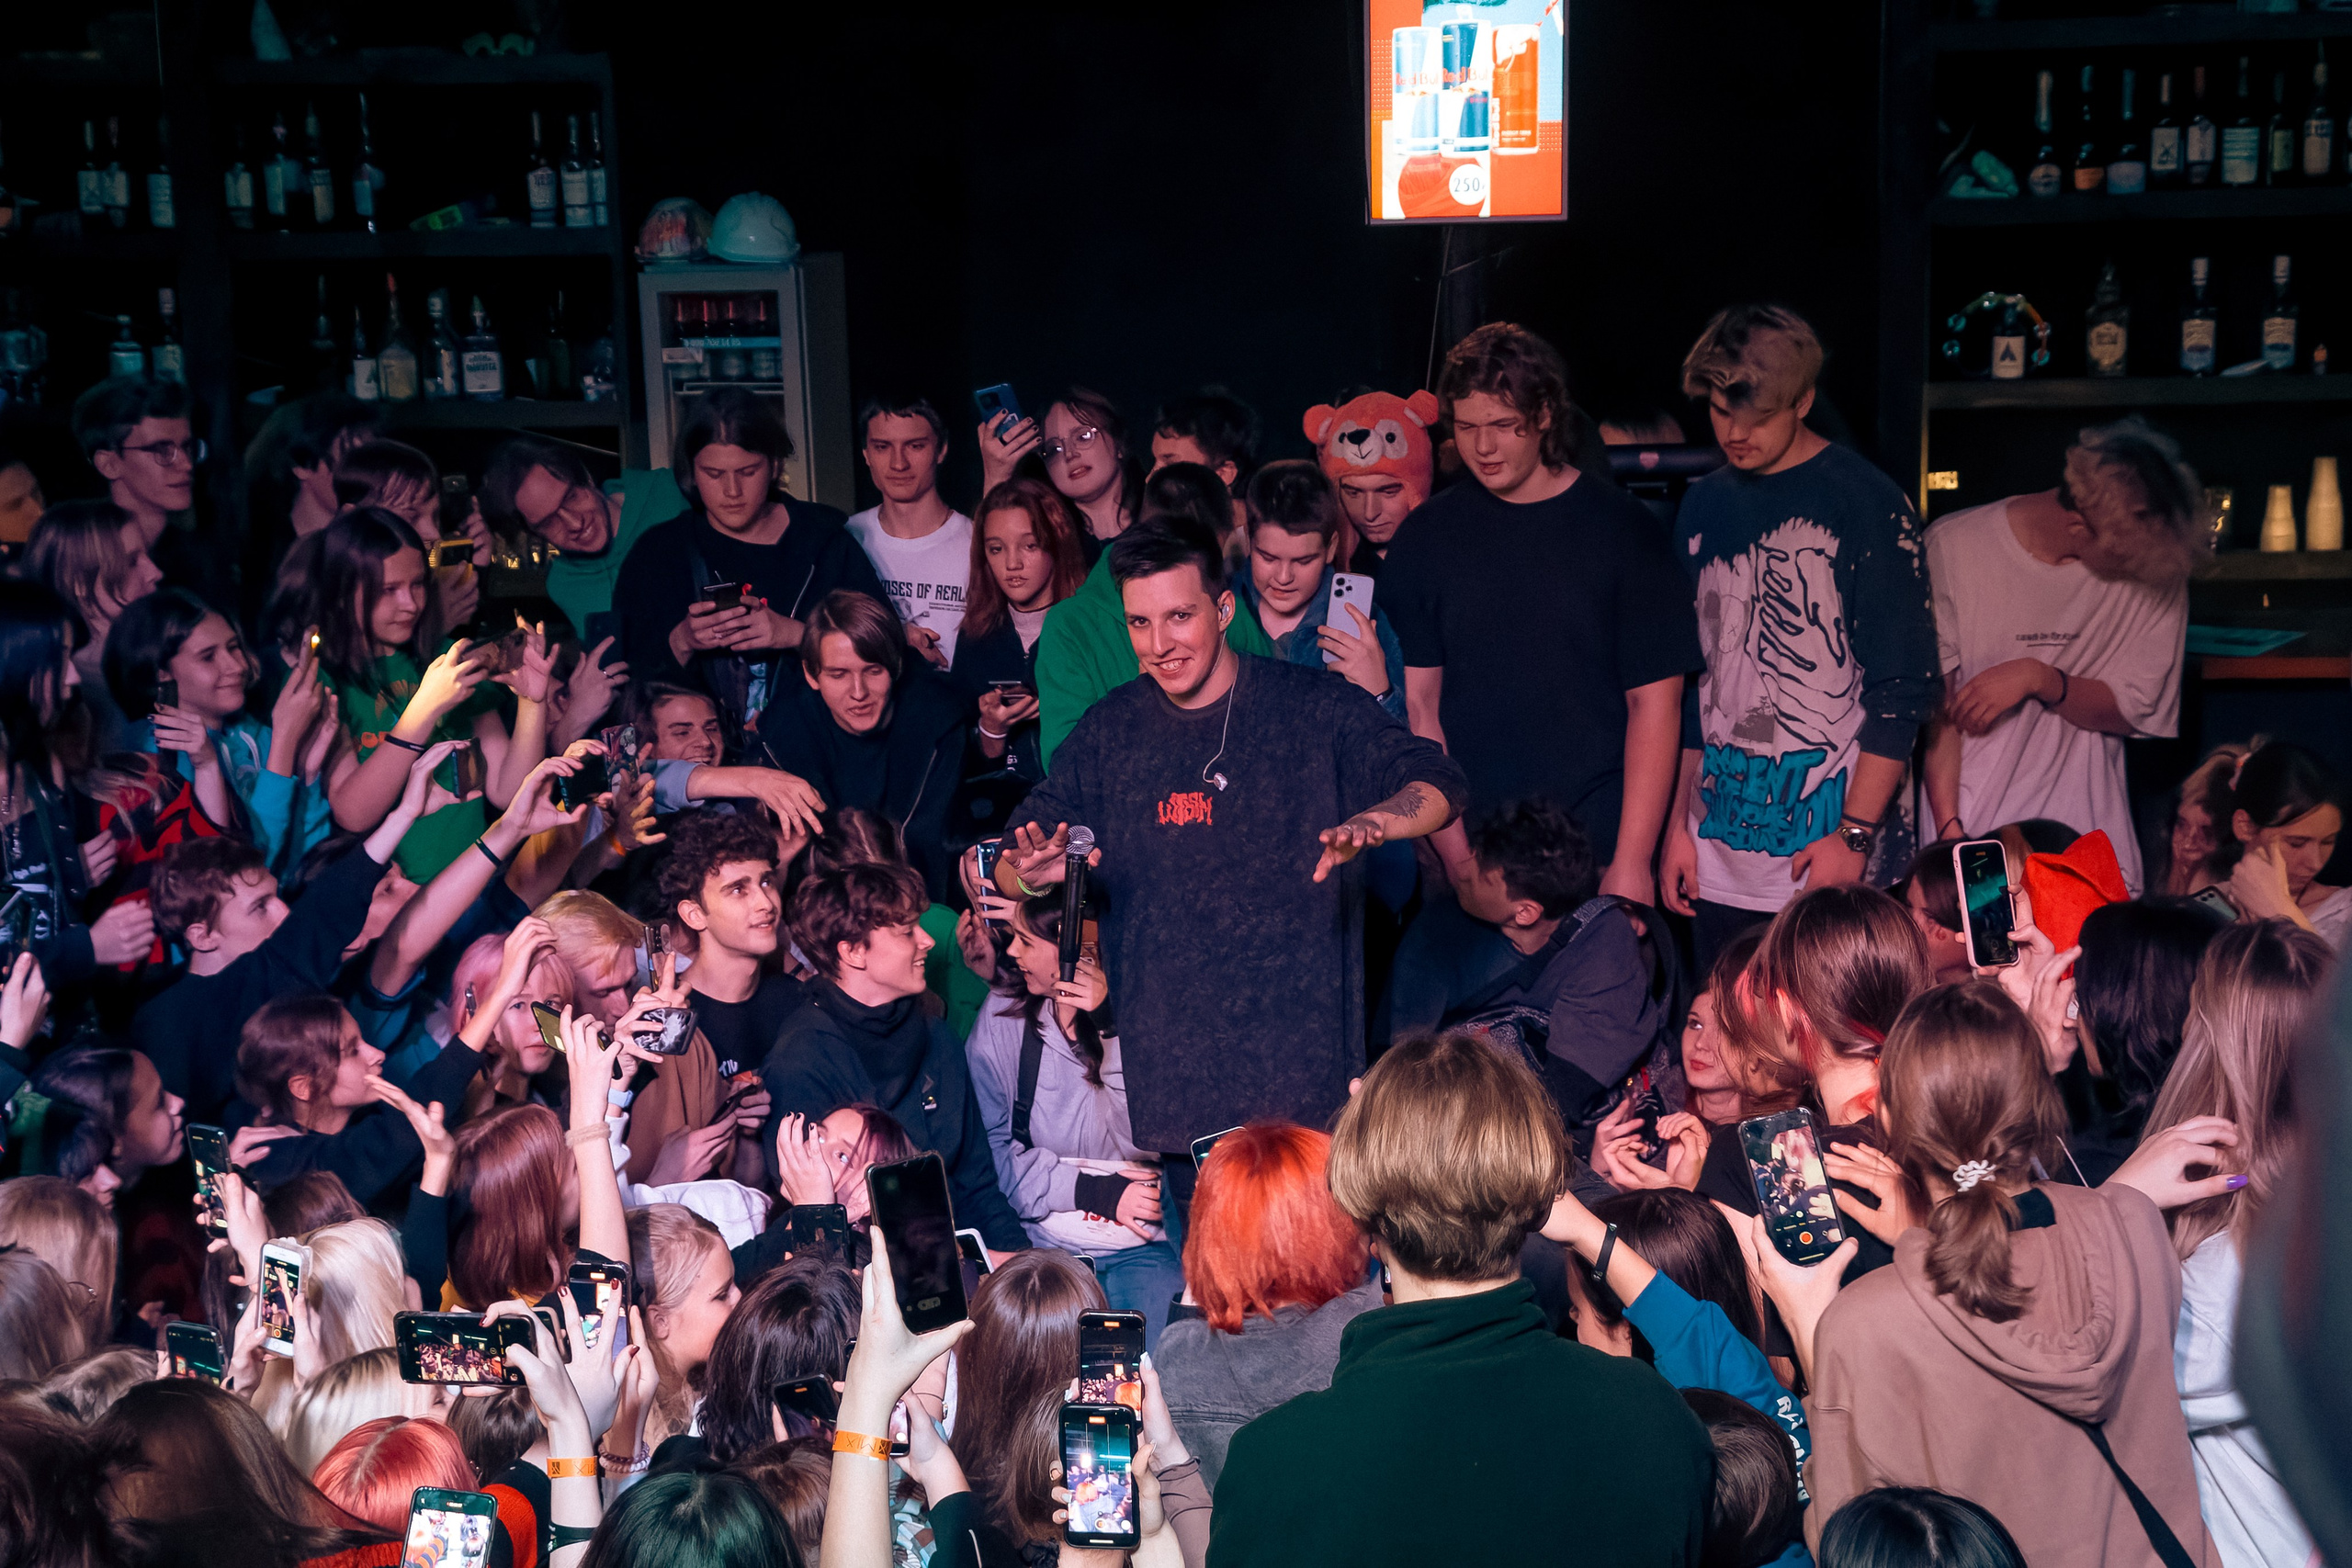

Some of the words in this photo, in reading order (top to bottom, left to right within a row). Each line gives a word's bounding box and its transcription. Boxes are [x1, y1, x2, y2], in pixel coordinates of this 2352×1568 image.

[1419, 72, 1440, 85] Bul
[1467, 67, 1489, 81] Bul
[917, 582, 932, 599] OF
